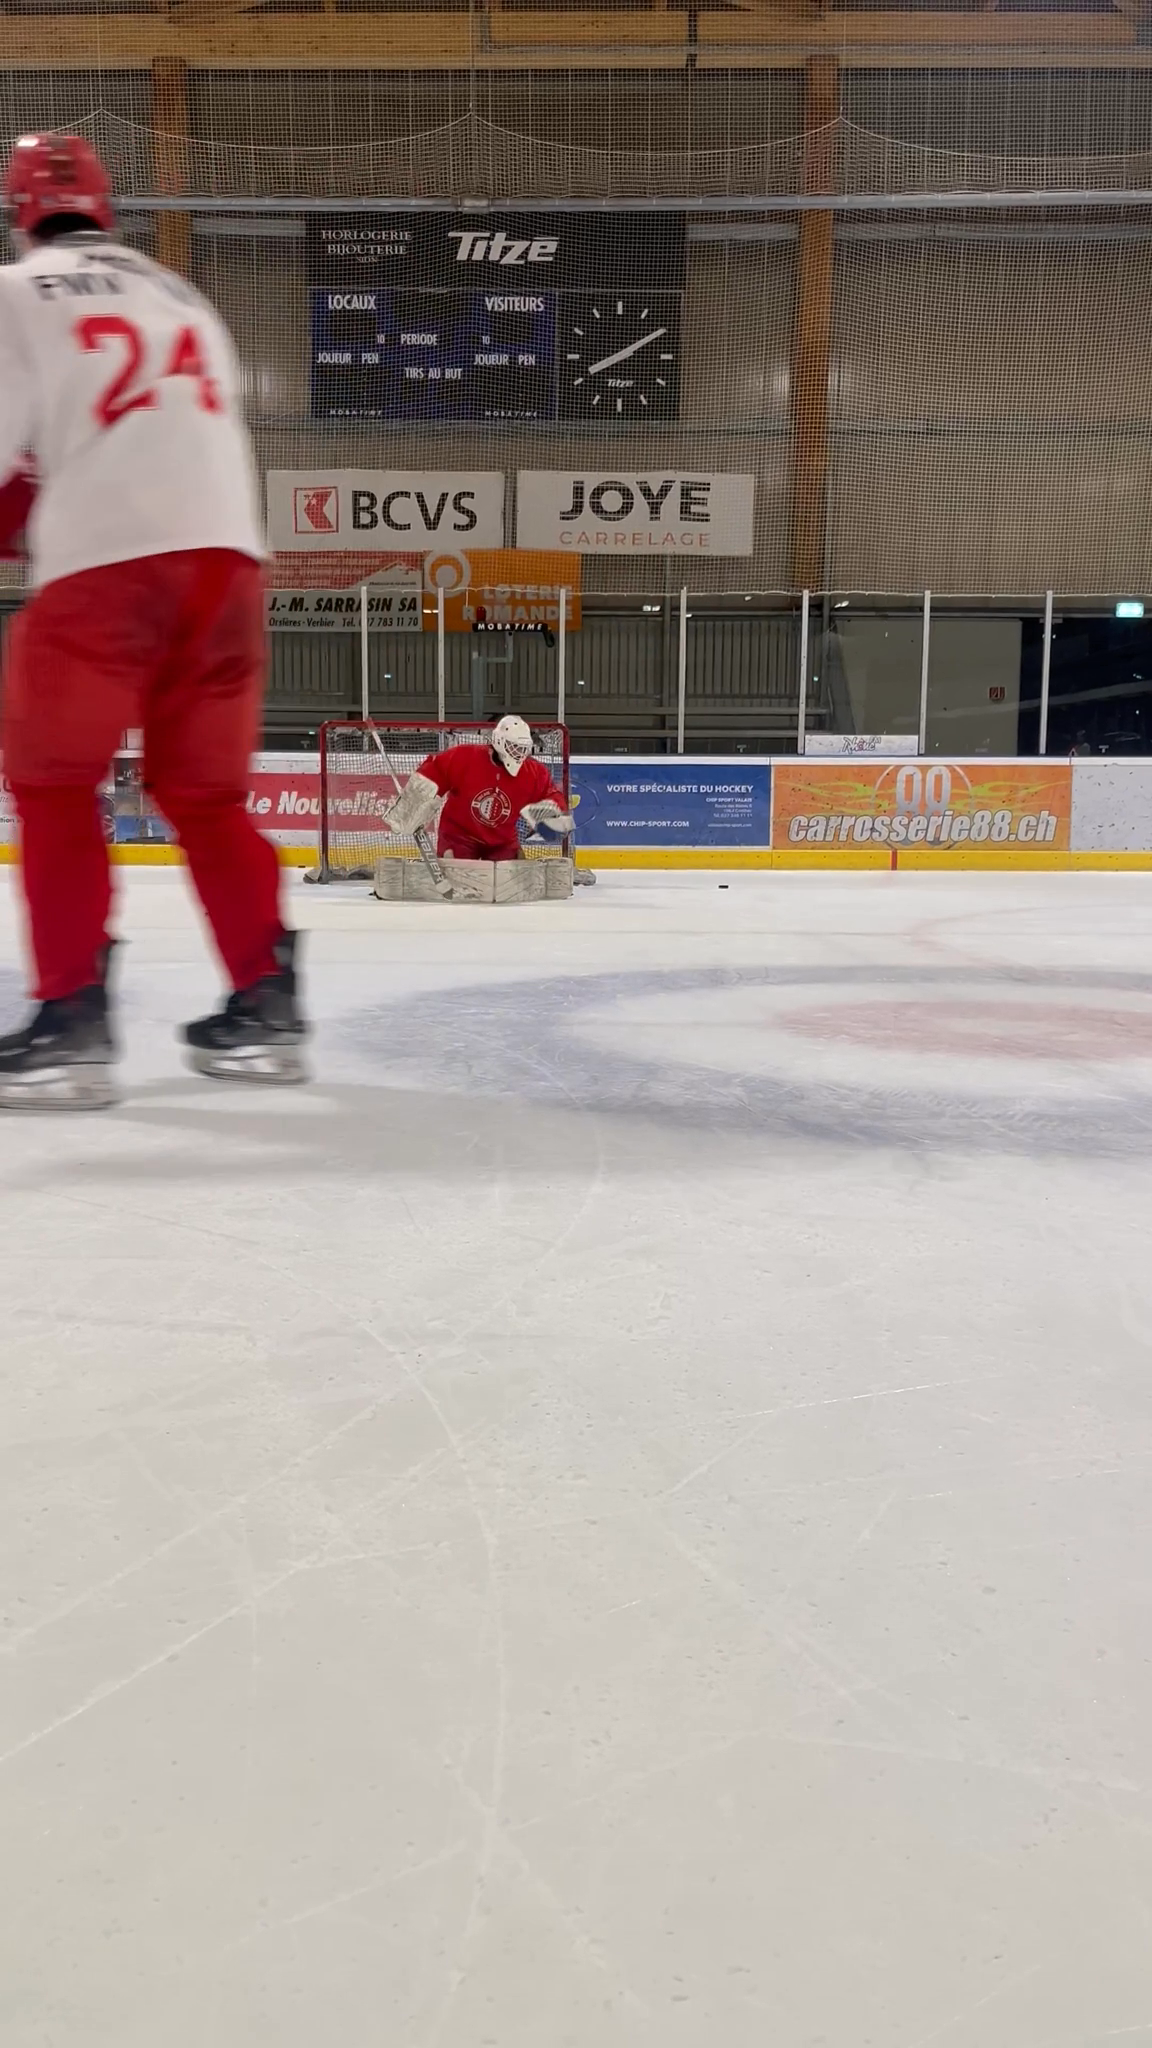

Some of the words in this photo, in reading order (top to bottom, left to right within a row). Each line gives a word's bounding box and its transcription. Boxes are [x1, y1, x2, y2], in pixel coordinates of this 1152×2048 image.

[321, 230, 412, 240] HORLOGERIE
[327, 244, 407, 255] BIJOUTERIE
[328, 295, 376, 310] LOCAUX
[485, 296, 545, 312] VISITEURS
[376, 334, 385, 344] 10
[400, 333, 438, 345] PERIODE
[481, 335, 490, 345] 10
[316, 352, 352, 364] JOUEUR
[361, 353, 379, 364] PEN
[473, 354, 509, 366] JOUEUR
[518, 354, 536, 366] PEN
[404, 367, 424, 379] TIRS
[428, 368, 441, 379] AU
[445, 368, 463, 379] BUT
[559, 480, 711, 522] JOYE
[351, 490, 478, 531] BCVS
[559, 531, 711, 548] CARRELAGE
[398, 597, 417, 612] SA
[377, 617, 393, 627] 783
[396, 617, 404, 626] 11
[408, 616, 419, 626] 70
[477, 623, 543, 631] MOBATIME
[607, 785, 637, 793] VOTRE
[700, 785, 713, 793] DU
[715, 785, 753, 793] HOCKEY
[246, 791, 272, 814] Le
[606, 820, 689, 828] WWW.CHIP-SPORT.COM
[788, 809, 1059, 843] carrosserie88.ch
